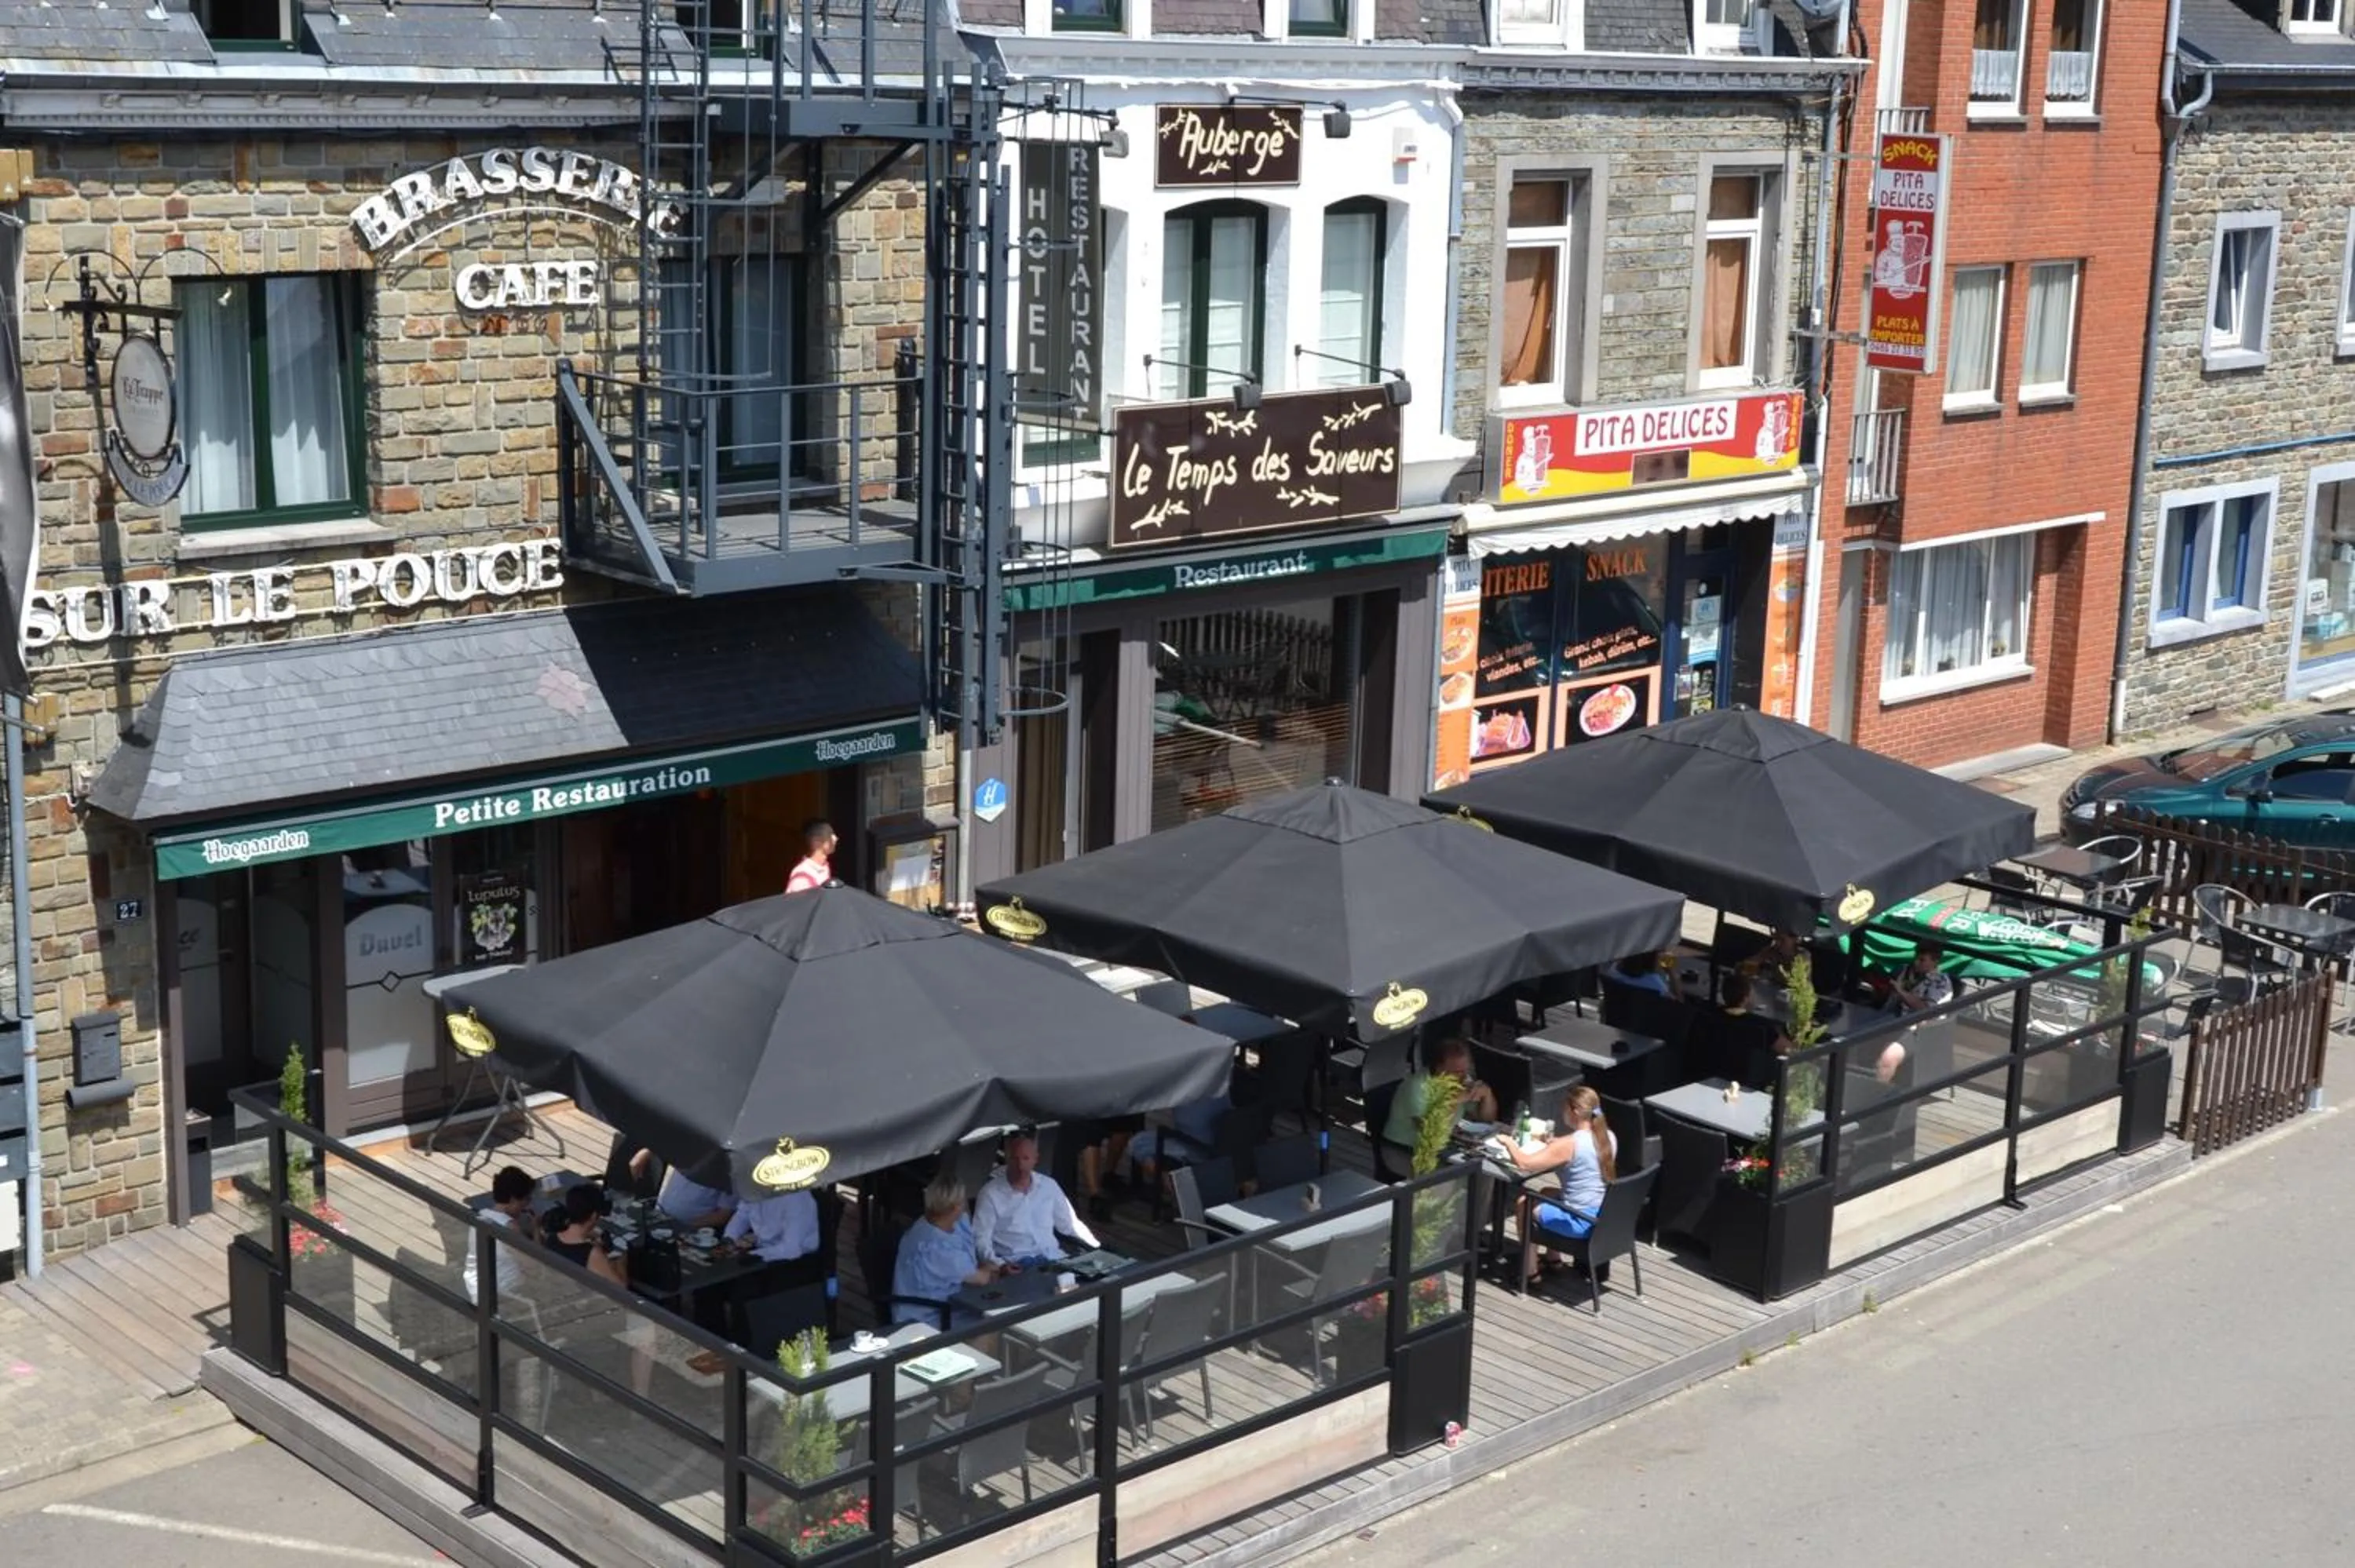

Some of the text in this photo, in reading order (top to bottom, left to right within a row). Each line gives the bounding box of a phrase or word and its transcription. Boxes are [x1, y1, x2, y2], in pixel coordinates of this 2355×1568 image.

[1179, 111, 1284, 177] Auberge
[1882, 140, 1937, 167] SNACK
[1893, 172, 1924, 189] PITA
[1879, 190, 1935, 210] DELICES
[455, 260, 600, 309] CAFE
[1027, 188, 1047, 374] HOTEL
[1069, 147, 1092, 421] RESTAURANT
[1585, 406, 1729, 449] PITA DELICES
[1124, 431, 1395, 505] Le Temps des Saveurs
[1174, 552, 1308, 588] Restaurant
[1586, 549, 1646, 582] SNACK
[23, 538, 564, 647] SUR LE POUCE
[815, 731, 895, 761] Hoegaarden
[435, 763, 711, 828] Petite Restauration
[202, 829, 309, 863] Hoegaarden
[119, 902, 137, 918] 27
[467, 885, 520, 903] Lupulus
[358, 924, 423, 957] Duvel
